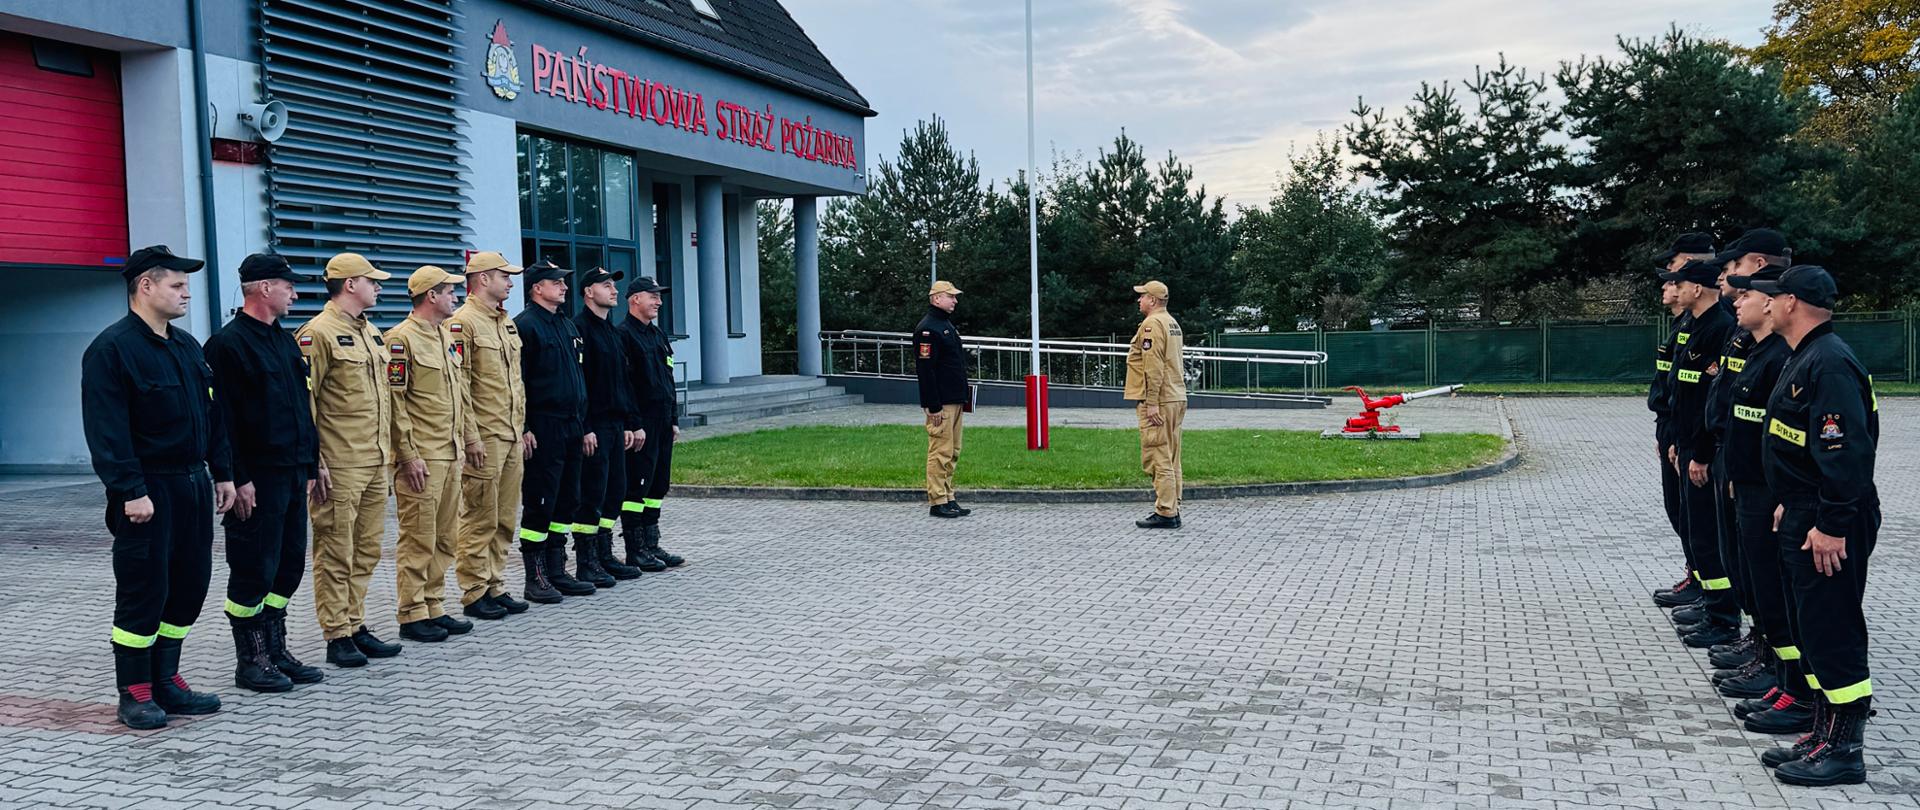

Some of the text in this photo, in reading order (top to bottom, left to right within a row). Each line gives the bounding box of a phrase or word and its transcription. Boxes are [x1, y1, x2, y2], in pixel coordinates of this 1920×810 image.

[531, 43, 857, 171] PAŃSTWOWA STRAŻ POŻARNA
